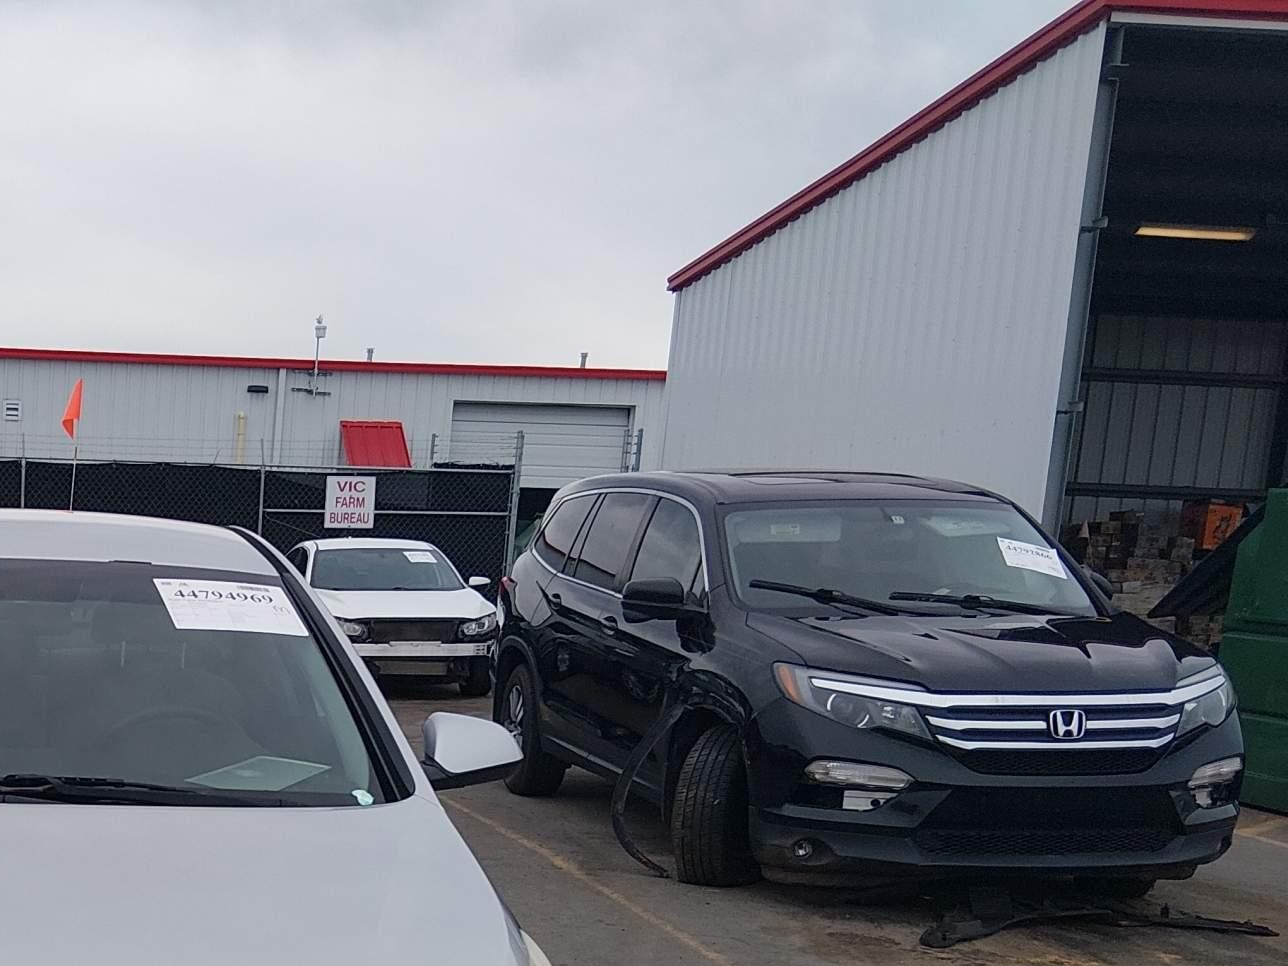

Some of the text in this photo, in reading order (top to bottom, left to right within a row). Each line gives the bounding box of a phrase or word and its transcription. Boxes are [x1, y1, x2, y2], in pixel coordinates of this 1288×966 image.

[337, 481, 366, 492] VIC
[336, 497, 365, 508] FARM
[329, 512, 369, 524] BUREAU
[174, 589, 274, 605] 44794969
